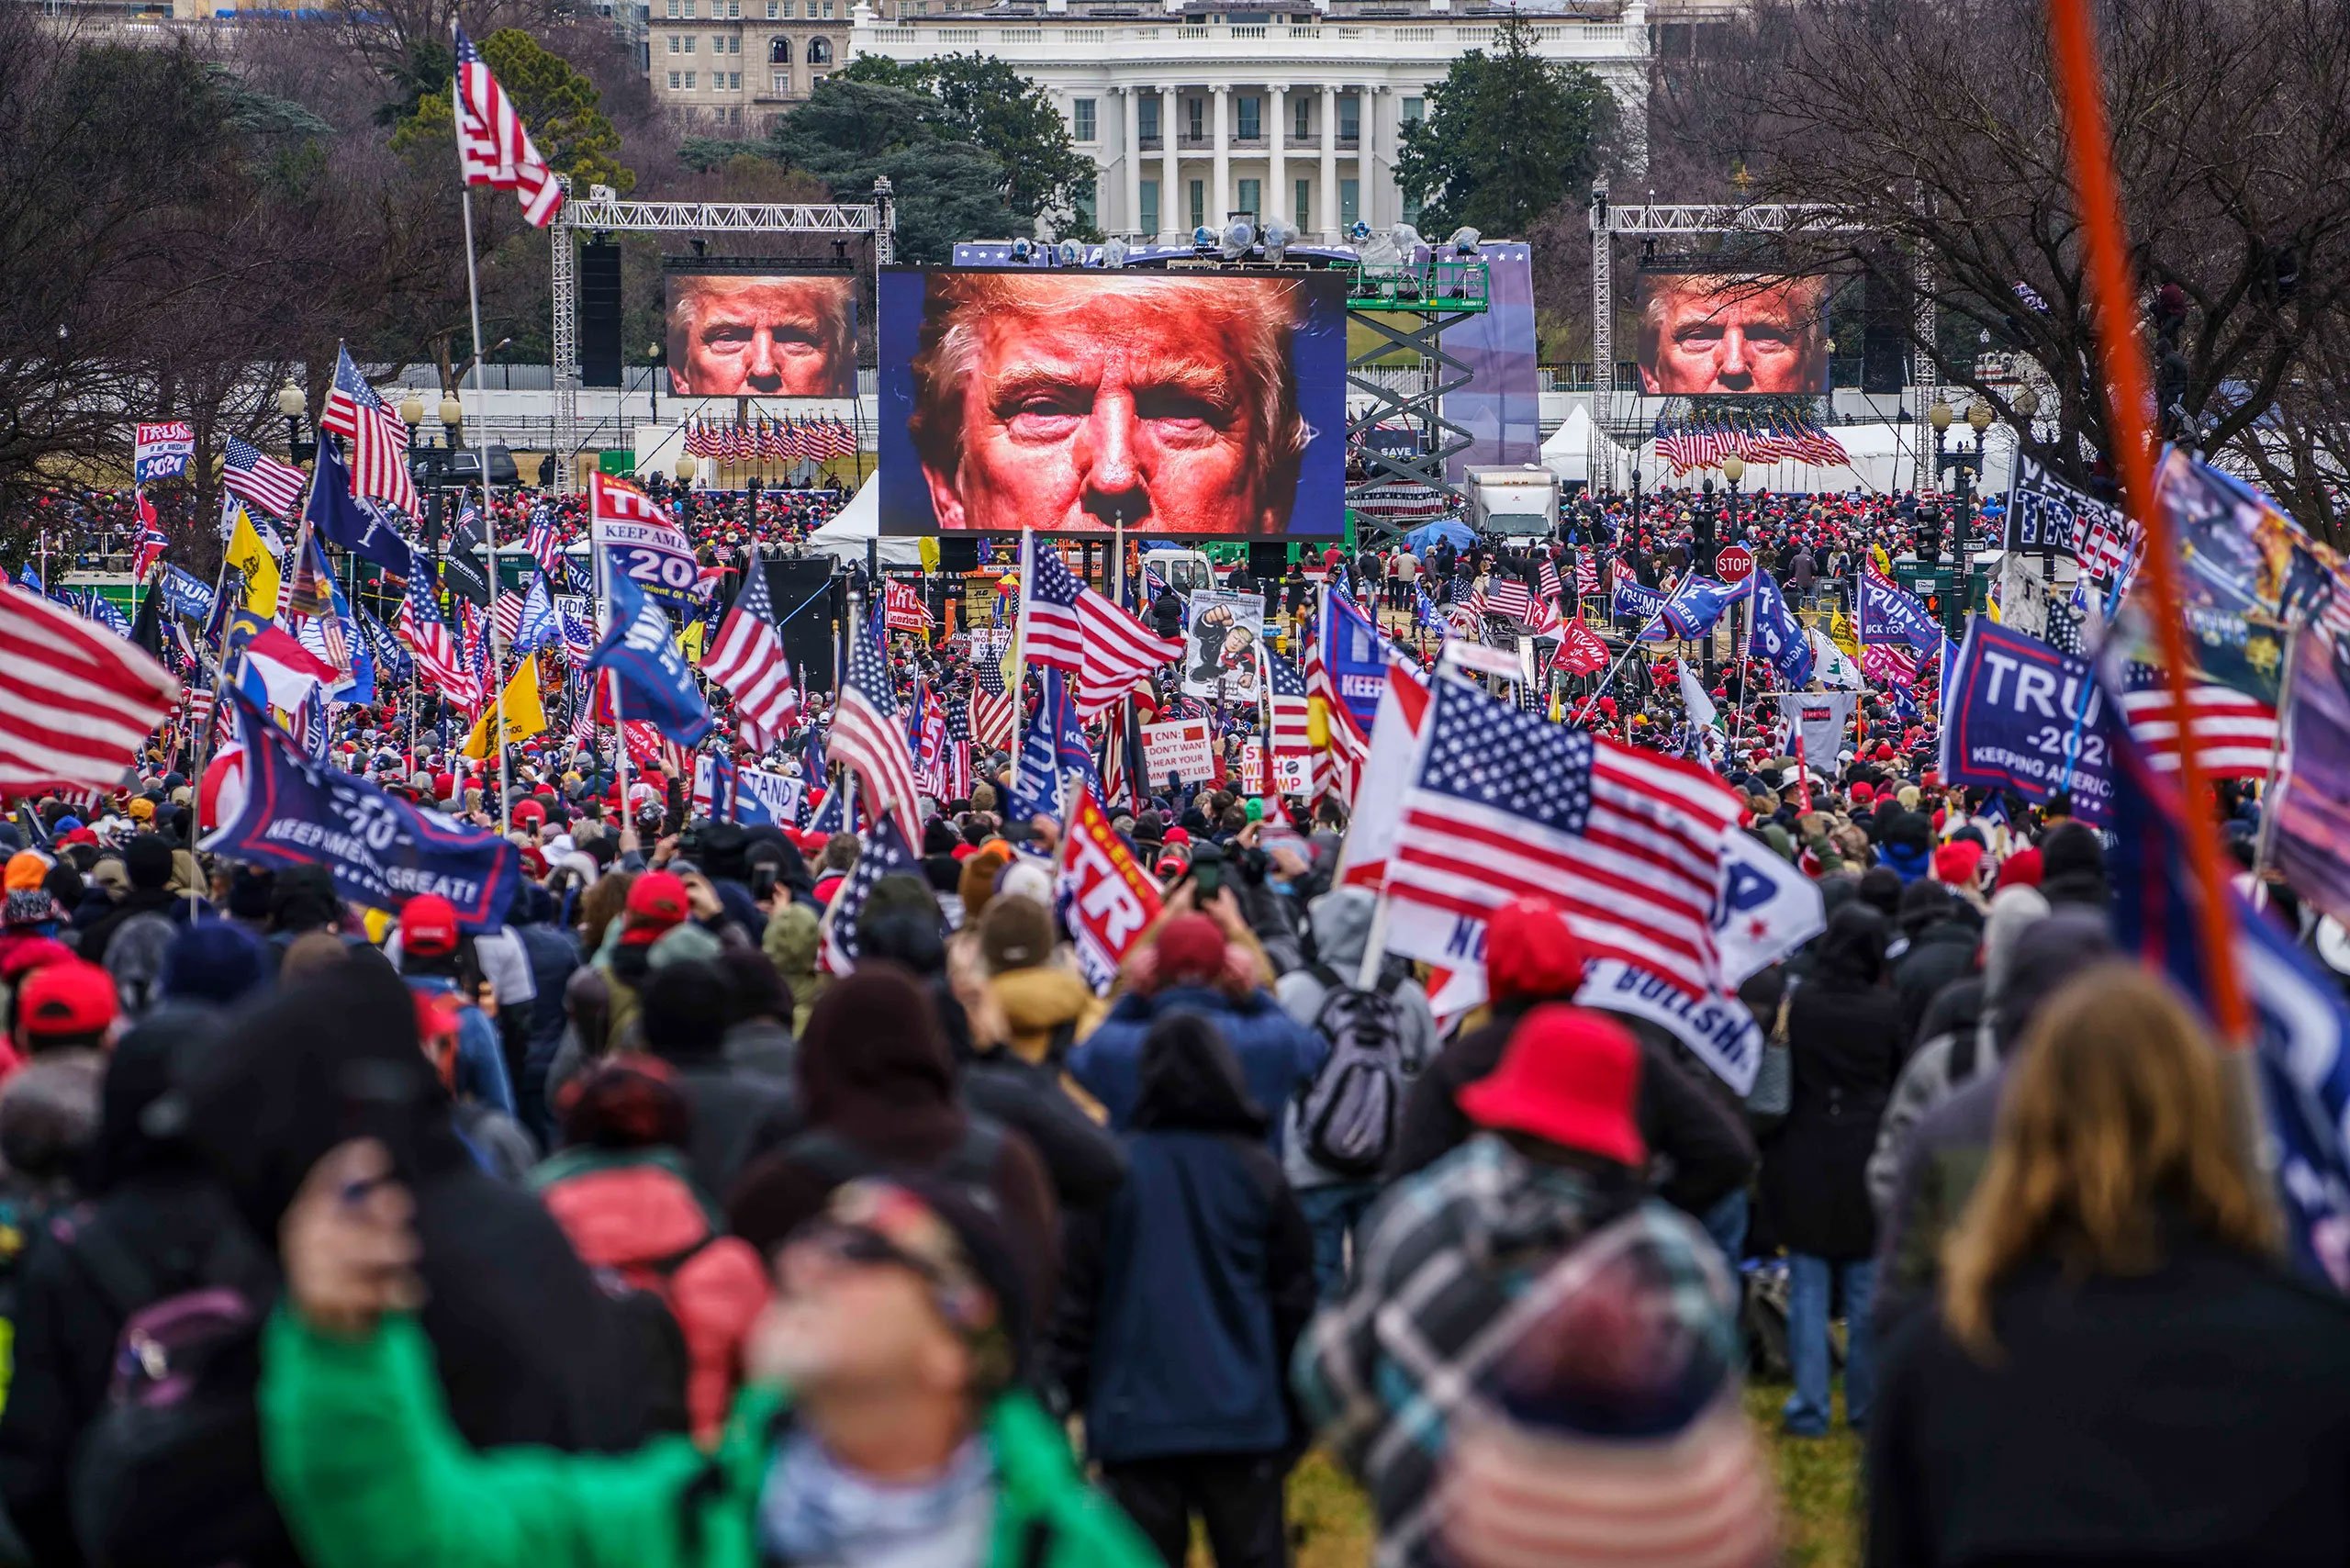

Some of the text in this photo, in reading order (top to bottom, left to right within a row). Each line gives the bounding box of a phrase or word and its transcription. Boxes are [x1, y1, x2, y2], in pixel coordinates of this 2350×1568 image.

[1381, 447, 1413, 456] SAVE
[605, 525, 647, 539] KEEP
[1719, 557, 1751, 571] STOP
[1670, 599, 1703, 633] GREAT!
[951, 633, 971, 641] FUCK
[1155, 731, 1181, 741] CNN:
[1149, 745, 1177, 756] DON'T
[1180, 742, 1207, 751] WANT
[2026, 725, 2111, 767] -202
[1154, 758, 1177, 767] HEAR
[1179, 755, 1204, 764] YOUR
[1973, 746, 2045, 777] KEEPING
[1193, 766, 1211, 775] LIES
[1245, 761, 1283, 776] WIH
[1245, 777, 1301, 791] TRMP
[266, 818, 325, 847] KEEP
[386, 865, 480, 905] GREAT!
